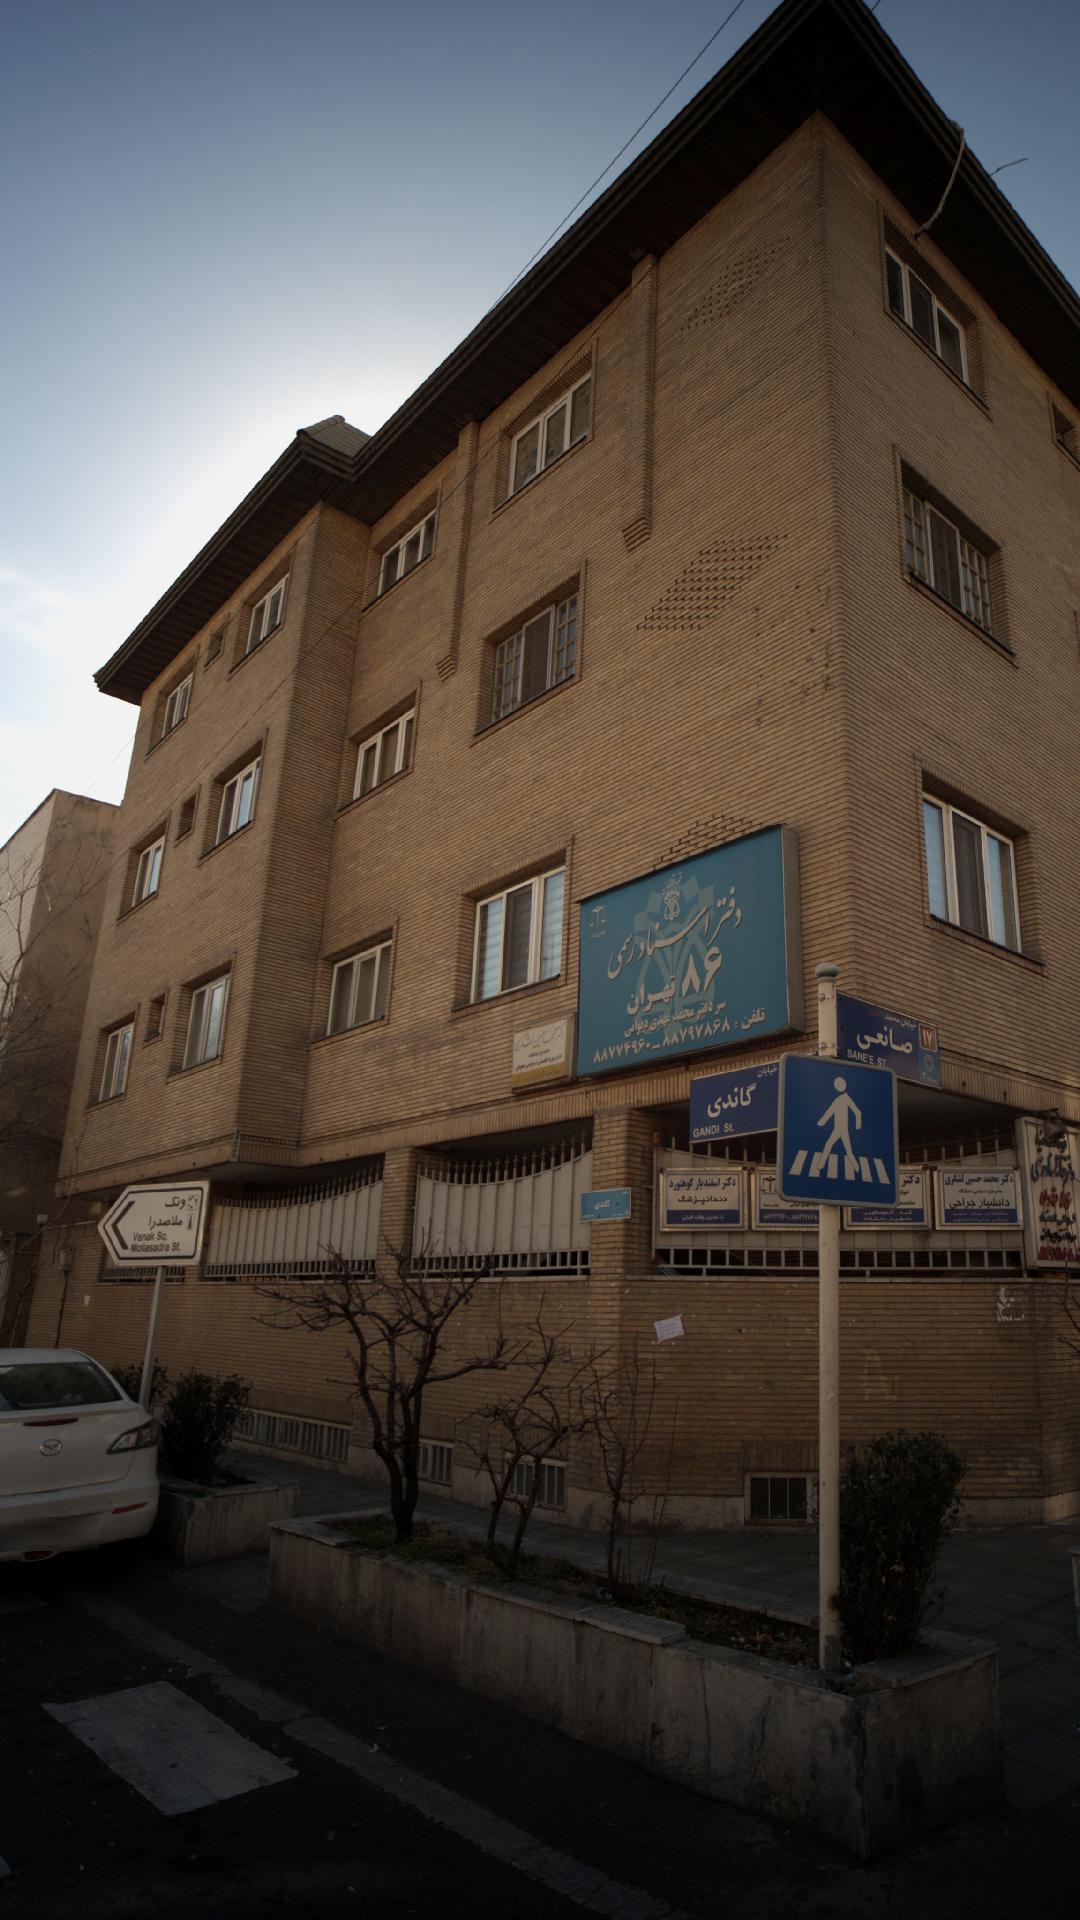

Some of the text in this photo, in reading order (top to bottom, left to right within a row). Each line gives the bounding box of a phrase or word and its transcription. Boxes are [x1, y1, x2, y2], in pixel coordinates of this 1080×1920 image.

[707, 885, 742, 947] دفتر
[638, 903, 711, 960] اسناد
[607, 933, 637, 980] رسمی
[681, 945, 723, 998] ۸۶
[626, 975, 677, 1016] تهران
[856, 1025, 913, 1054] صانعی
[922, 1027, 933, 1049] ۱۷
[706, 1082, 758, 1119] گاندی
[692, 1123, 720, 1139] GANDI
[721, 1176, 737, 1190] دکتر
[901, 1174, 921, 1187] دکتر
[965, 1175, 982, 1186] حسین
[1000, 1173, 1014, 1186] دکتر
[165, 1196, 186, 1210] ونک
[678, 1195, 728, 1205] دندانپزشک
[948, 1197, 1010, 1210] دانشیار جراحی
[148, 1215, 183, 1230] ملاصدرا
[133, 1231, 155, 1242] Vanak
